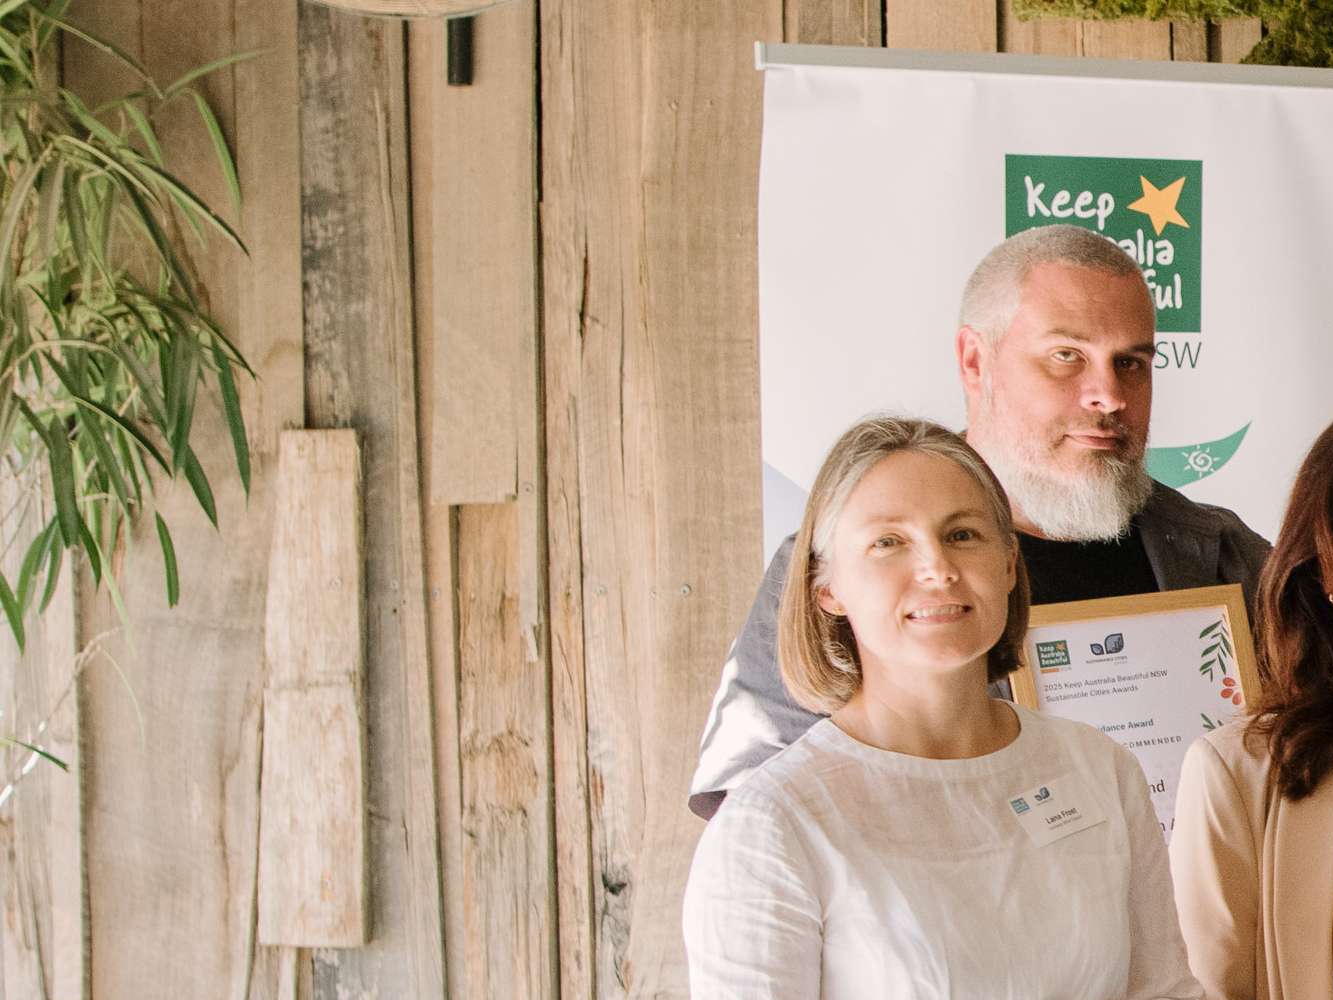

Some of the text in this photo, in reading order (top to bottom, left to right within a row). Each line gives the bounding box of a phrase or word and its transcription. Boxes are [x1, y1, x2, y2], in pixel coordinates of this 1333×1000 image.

[1024, 175, 1115, 230] Keep
[1155, 342, 1202, 369] SW
[1044, 670, 1168, 692] 2025 Keep Australia Beautiful NSW
[1046, 685, 1139, 703] Sustainable Cities Awards
[1097, 719, 1154, 733] idance Award
